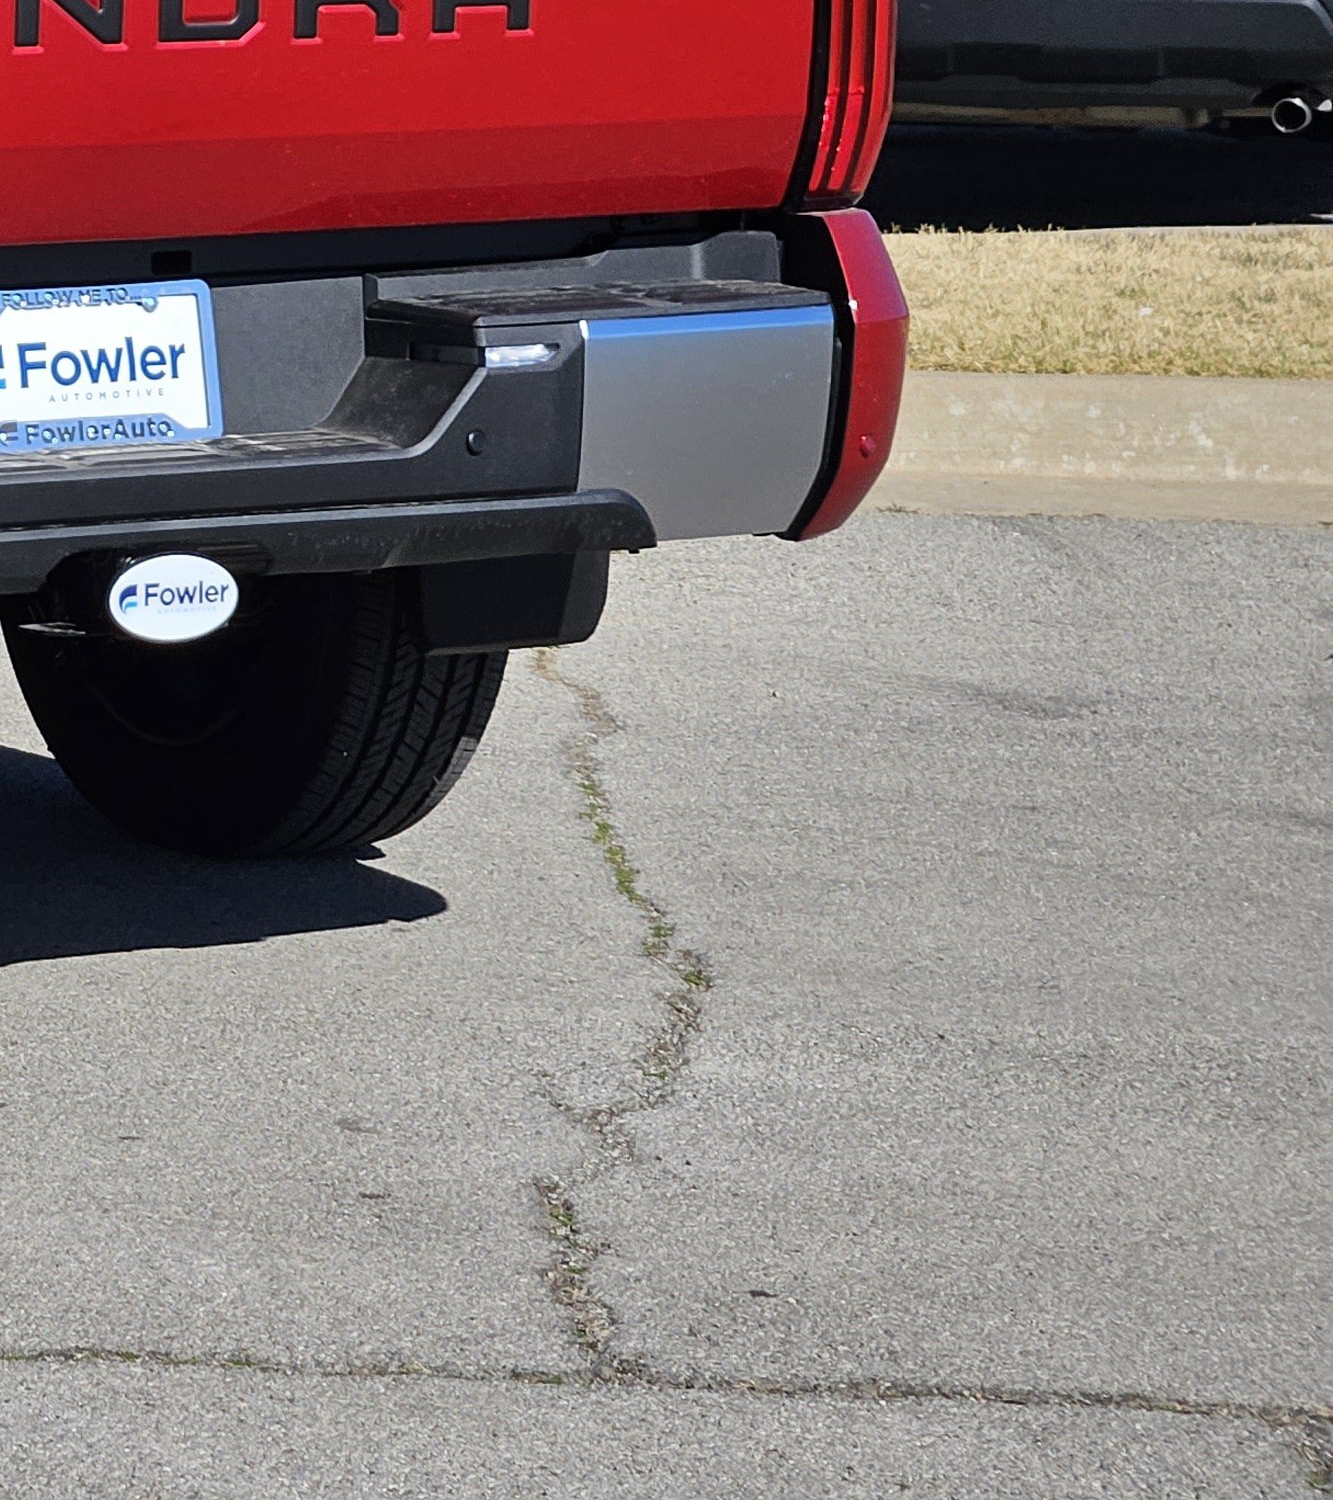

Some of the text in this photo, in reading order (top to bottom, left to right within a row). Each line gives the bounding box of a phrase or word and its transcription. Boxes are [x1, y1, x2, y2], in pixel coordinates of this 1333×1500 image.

[1, 288, 73, 308] FOLLOW
[16, 337, 186, 389] Fowler
[48, 387, 165, 403] AUTOMOTIVE
[25, 417, 172, 444] FowlerAuto
[145, 580, 229, 606] Fowler
